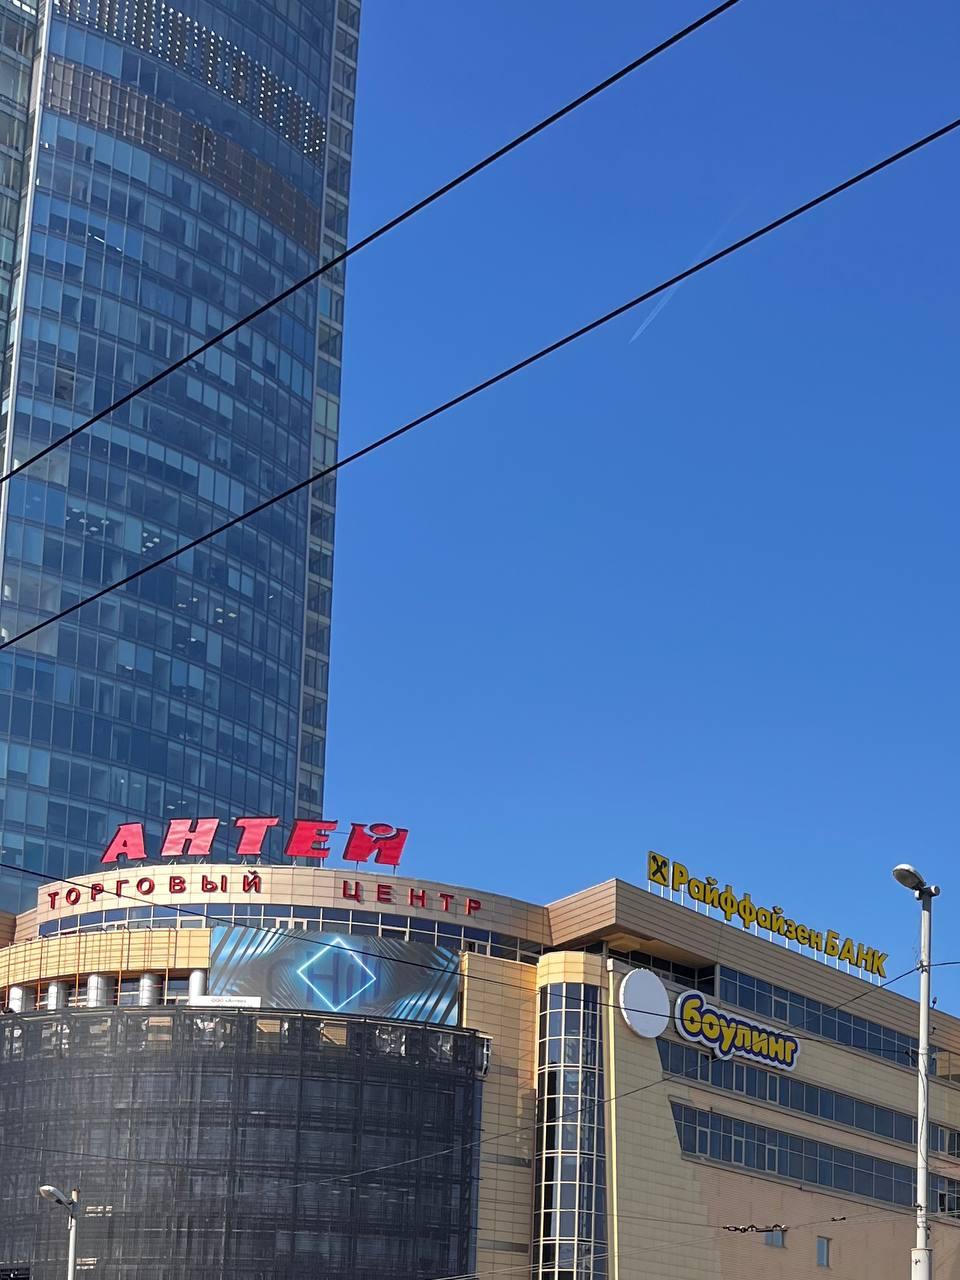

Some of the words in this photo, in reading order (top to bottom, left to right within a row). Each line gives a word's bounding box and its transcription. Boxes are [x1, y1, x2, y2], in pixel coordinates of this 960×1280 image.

[101, 815, 408, 866] АНТЕЙ
[48, 870, 262, 910] ТОРГОВЫЙ
[343, 879, 484, 916] ЦЕНТР
[681, 998, 796, 1064] боулинг
